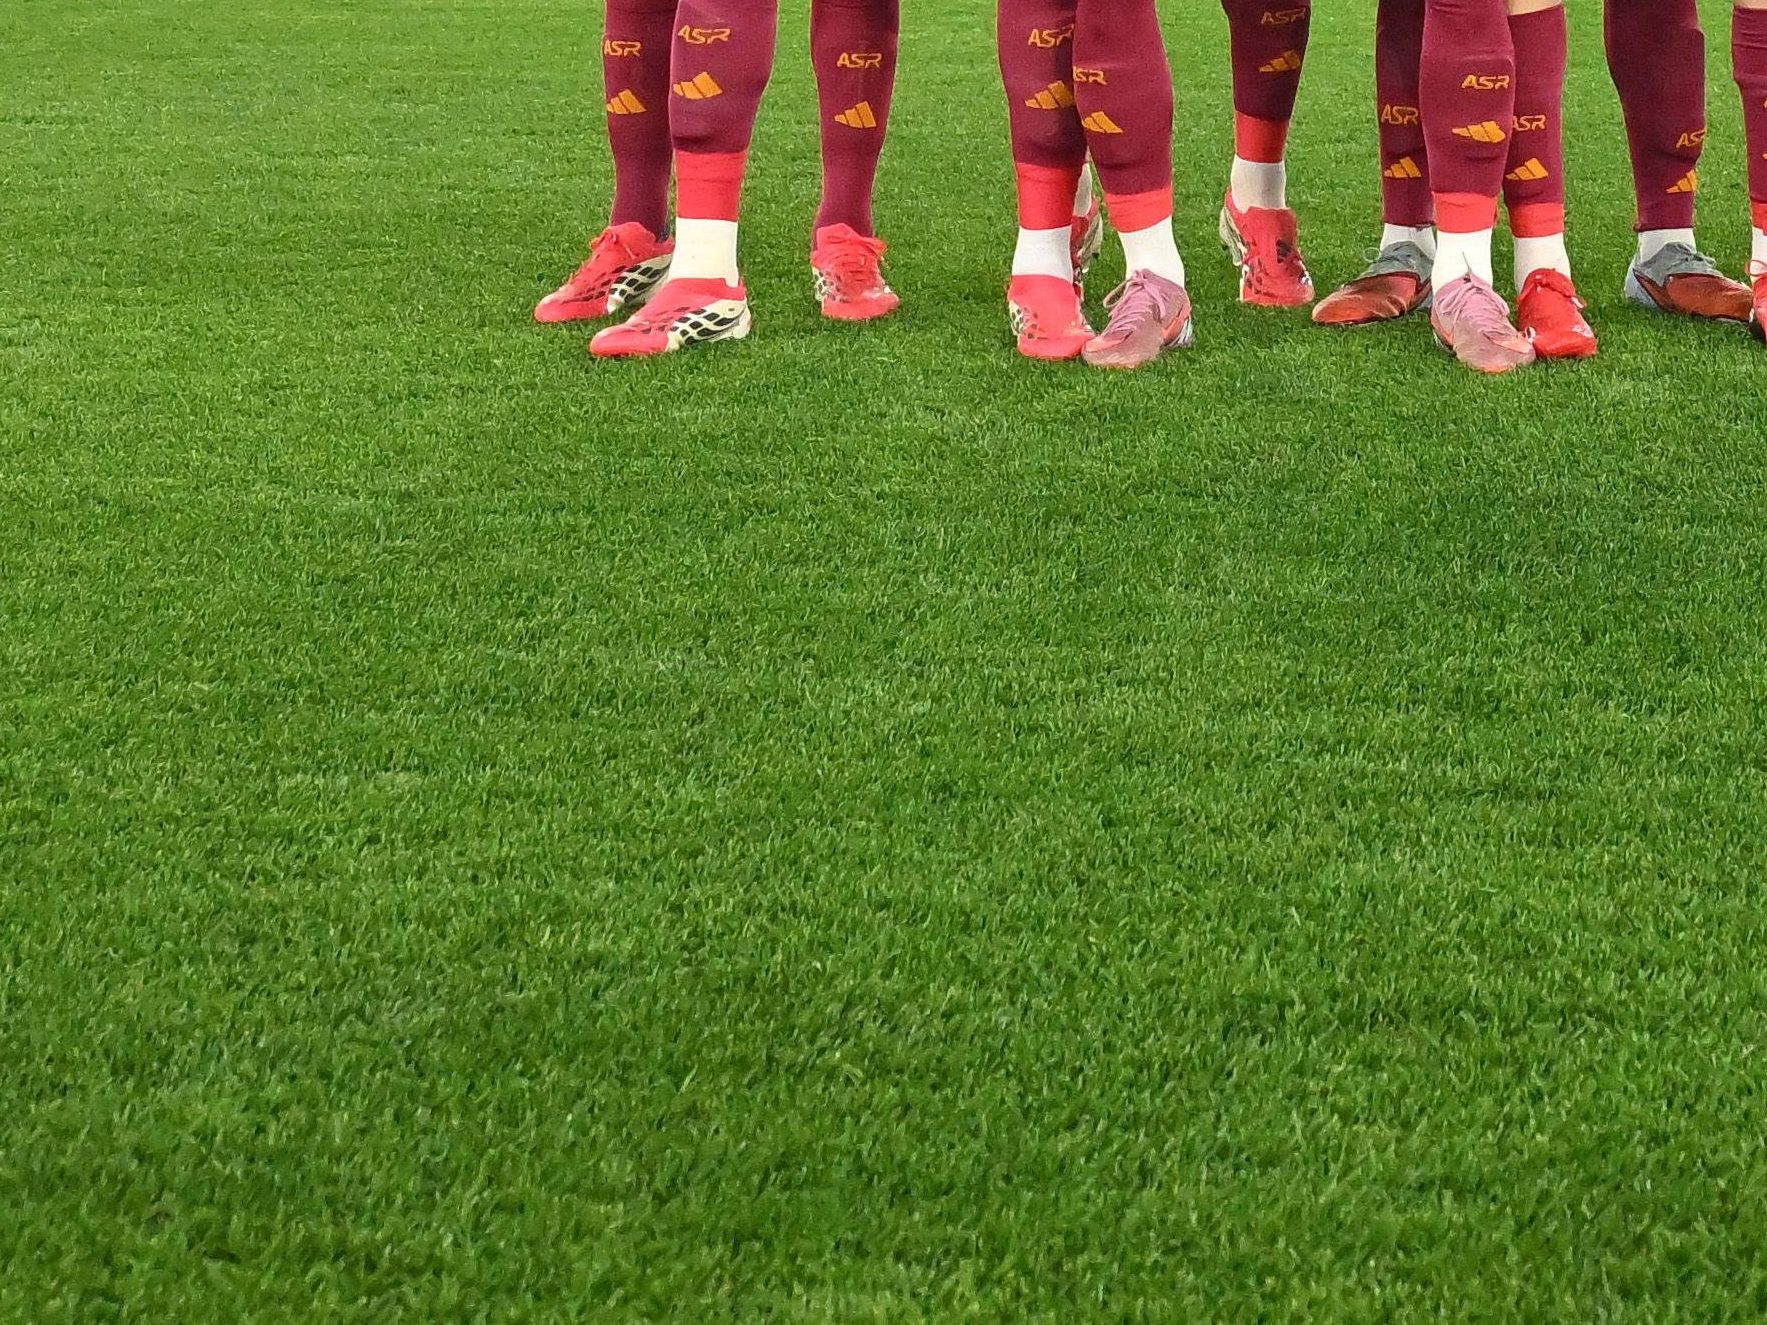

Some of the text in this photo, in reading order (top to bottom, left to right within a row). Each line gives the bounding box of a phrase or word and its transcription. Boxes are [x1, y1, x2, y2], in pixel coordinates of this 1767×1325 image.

[678, 25, 731, 44] ASR
[604, 40, 642, 58] ASR
[836, 52, 883, 68] ASR
[1461, 74, 1510, 90] ASR
[1380, 104, 1419, 125] ASR
